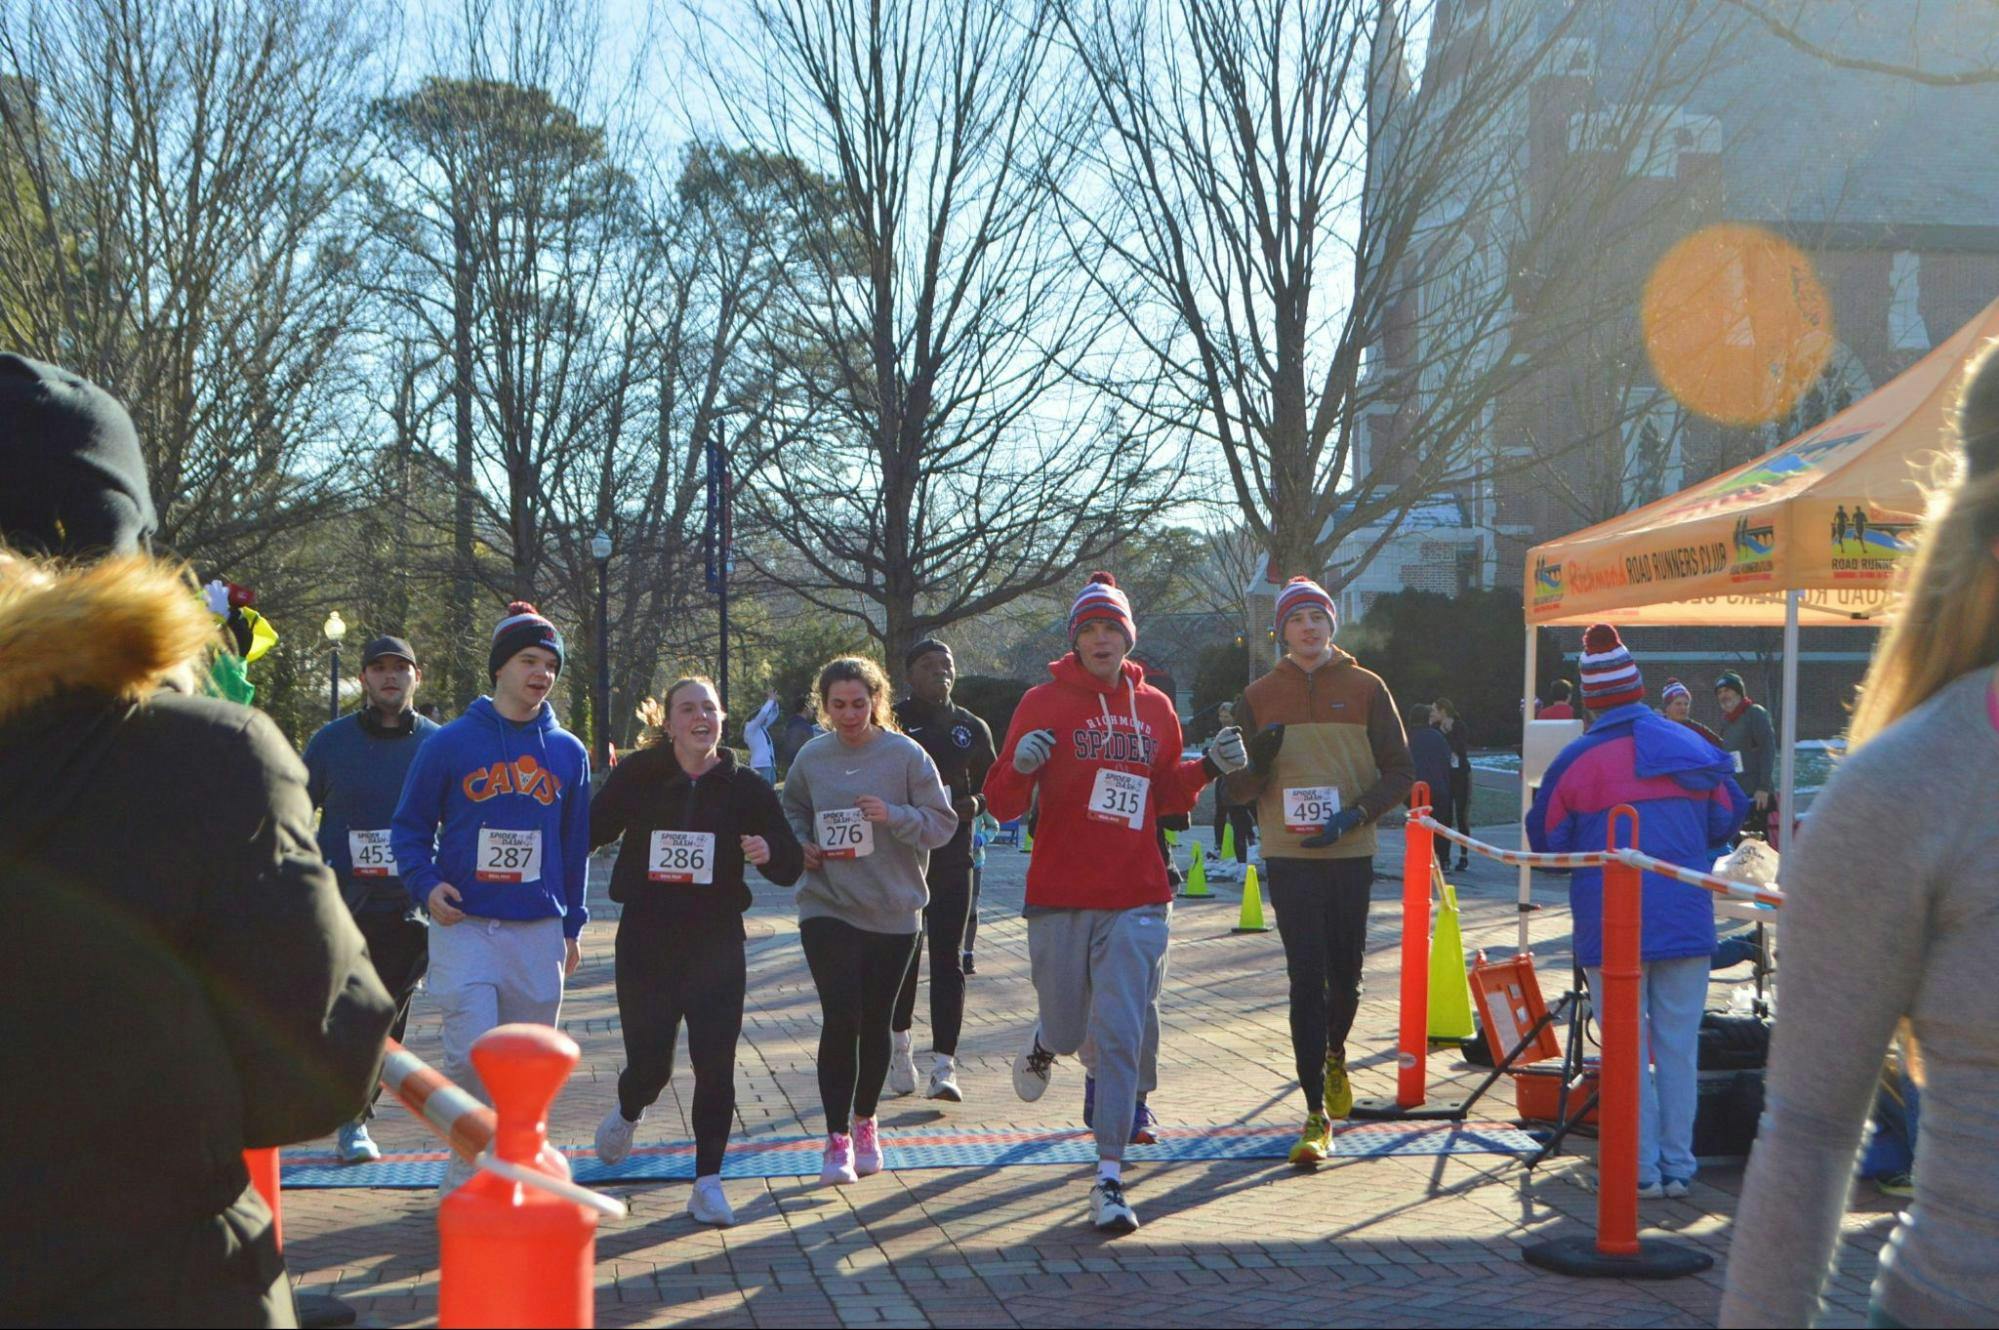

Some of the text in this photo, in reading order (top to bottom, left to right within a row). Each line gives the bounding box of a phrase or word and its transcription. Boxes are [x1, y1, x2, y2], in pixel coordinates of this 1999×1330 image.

[1626, 553, 1652, 585] ROAD
[1652, 546, 1699, 581] RUNNERS
[1699, 541, 1727, 575] CLUB
[1831, 558, 1858, 570] ROAD
[1086, 714, 1152, 735] RICHMOND
[463, 754, 562, 806] CAVS
[1102, 787, 1140, 814] 315
[1292, 802, 1334, 821] 495
[826, 824, 863, 845] 276
[359, 845, 396, 864] 453
[488, 847, 533, 868] 287
[659, 847, 705, 869] 286
